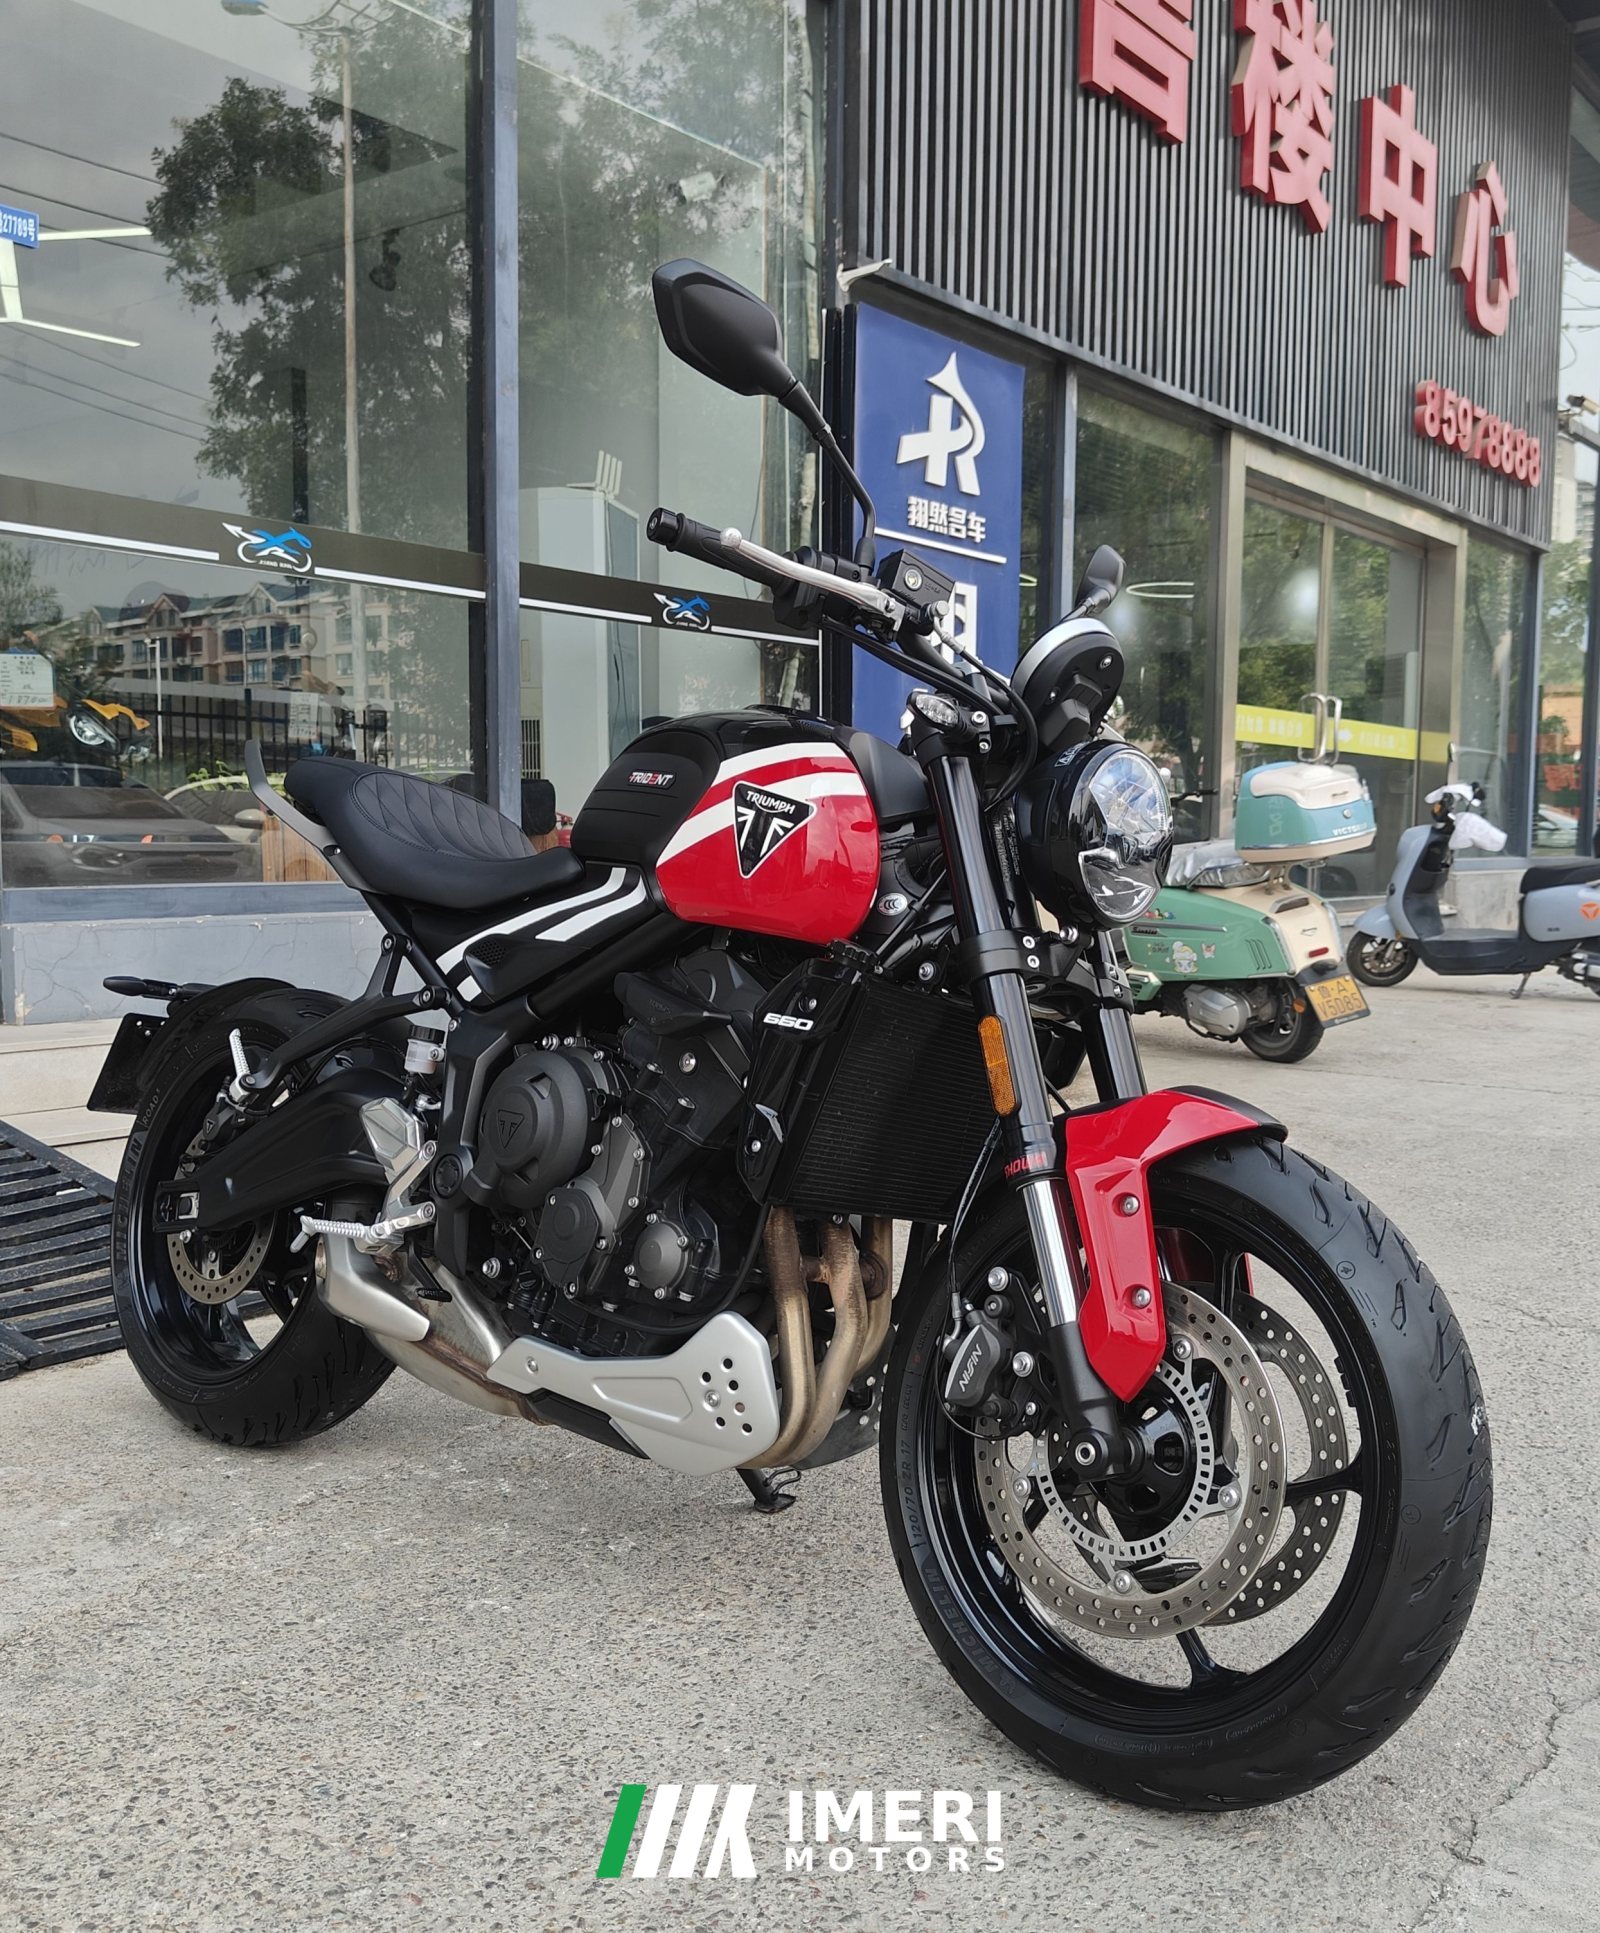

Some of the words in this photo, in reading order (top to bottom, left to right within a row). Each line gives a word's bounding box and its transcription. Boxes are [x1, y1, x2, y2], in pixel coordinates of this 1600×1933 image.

[0, 211, 35, 242] 27789号
[1414, 379, 1541, 488] 85978888
[907, 495, 987, 543] 翔然名车
[629, 771, 673, 787] TRIDENT
[746, 791, 796, 815] TRIUMPH
[1317, 992, 1363, 1018] V5D85
[763, 1012, 814, 1031] 660
[959, 1343, 982, 1393] NISSIN
[900, 1440, 911, 1457] 17
[901, 1461, 912, 1479] ZR
[903, 1485, 922, 1539] 120/70
[924, 1568, 999, 1674] MICHELIN
